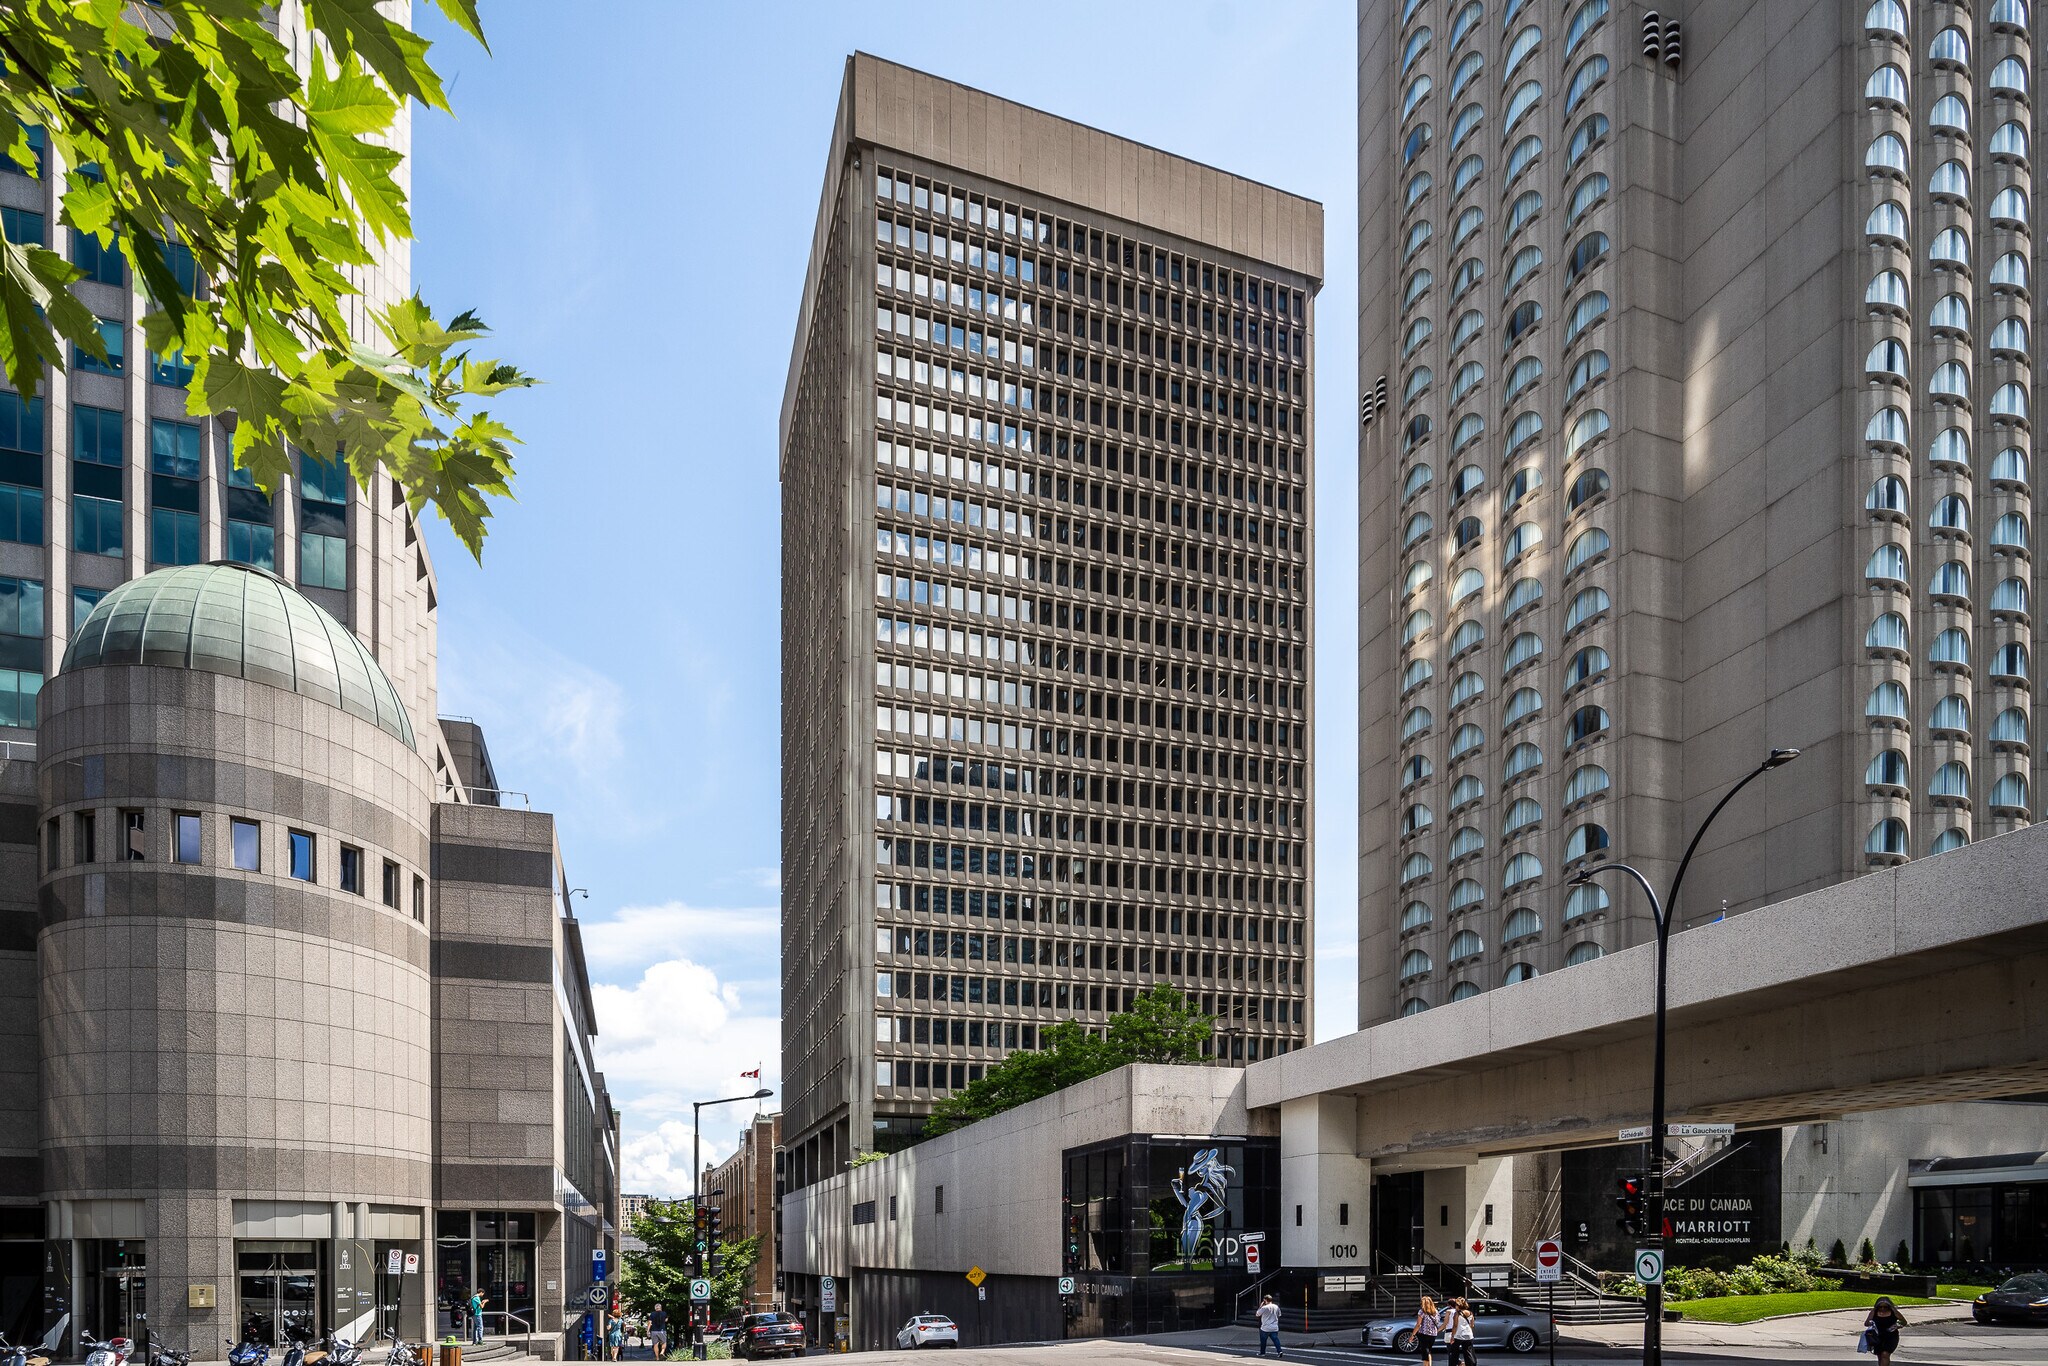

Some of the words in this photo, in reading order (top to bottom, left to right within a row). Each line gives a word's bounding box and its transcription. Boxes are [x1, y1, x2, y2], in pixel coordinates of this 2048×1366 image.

[1662, 1199, 1685, 1211] ACE
[1690, 1199, 1705, 1211] DU
[1710, 1199, 1752, 1211] CANADA
[1675, 1221, 1751, 1232] MARRIOTT
[1675, 1236, 1701, 1244] MONTRÉAL
[1329, 1244, 1358, 1258] 1010
[1091, 1284, 1100, 1295] DU
[1101, 1285, 1124, 1296] CANADA
